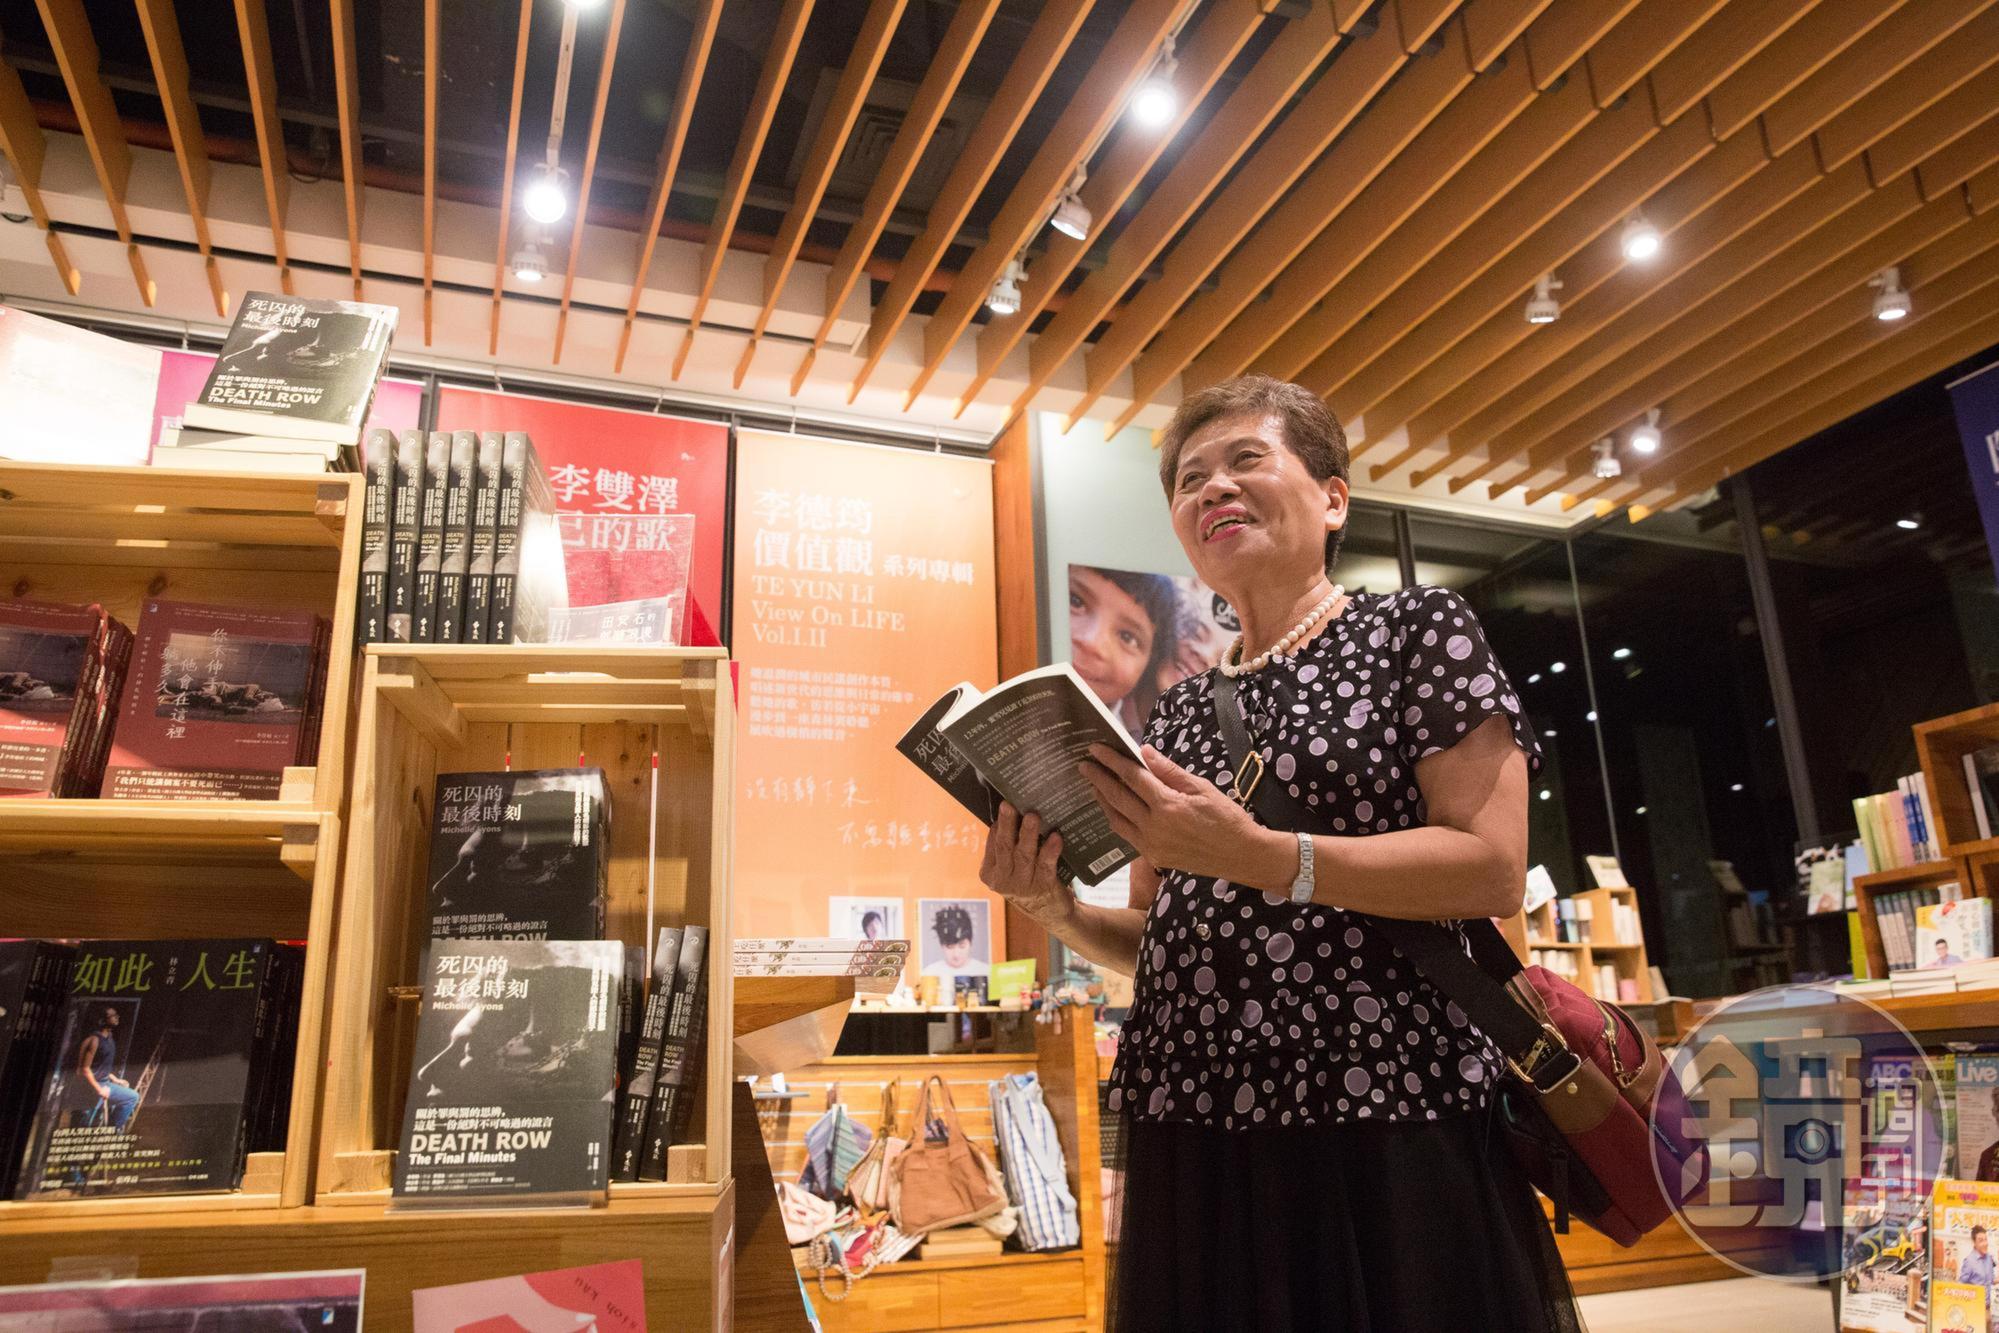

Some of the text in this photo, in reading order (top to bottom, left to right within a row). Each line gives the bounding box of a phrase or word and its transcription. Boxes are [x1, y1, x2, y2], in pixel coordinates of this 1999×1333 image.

[249, 298, 306, 317] 死囚的
[243, 311, 320, 329] 最後時刻
[207, 395, 291, 409] The Final Minutes
[209, 387, 322, 405] DEATH ROW
[550, 464, 679, 514] 李雙澤
[753, 488, 873, 534] 李德筠
[754, 528, 975, 586] 價值觀 系列專輯
[751, 575, 875, 605] TE YUN LI
[751, 600, 905, 632] View On LIFE
[203, 627, 238, 694] 你不伸手
[164, 657, 198, 739] 他會在這裡
[986, 729, 1043, 767] DEATH ROW
[443, 784, 503, 803] 死囚的
[441, 804, 522, 823] 最後時刻
[72, 950, 257, 993] 如此 人生
[436, 955, 508, 975] 死囚的
[434, 978, 529, 1000] 最後時刻
[1957, 1060, 1998, 1083] Live
[410, 1130, 552, 1152] DEATH ROW
[409, 1151, 516, 1165] The Final Minutes
